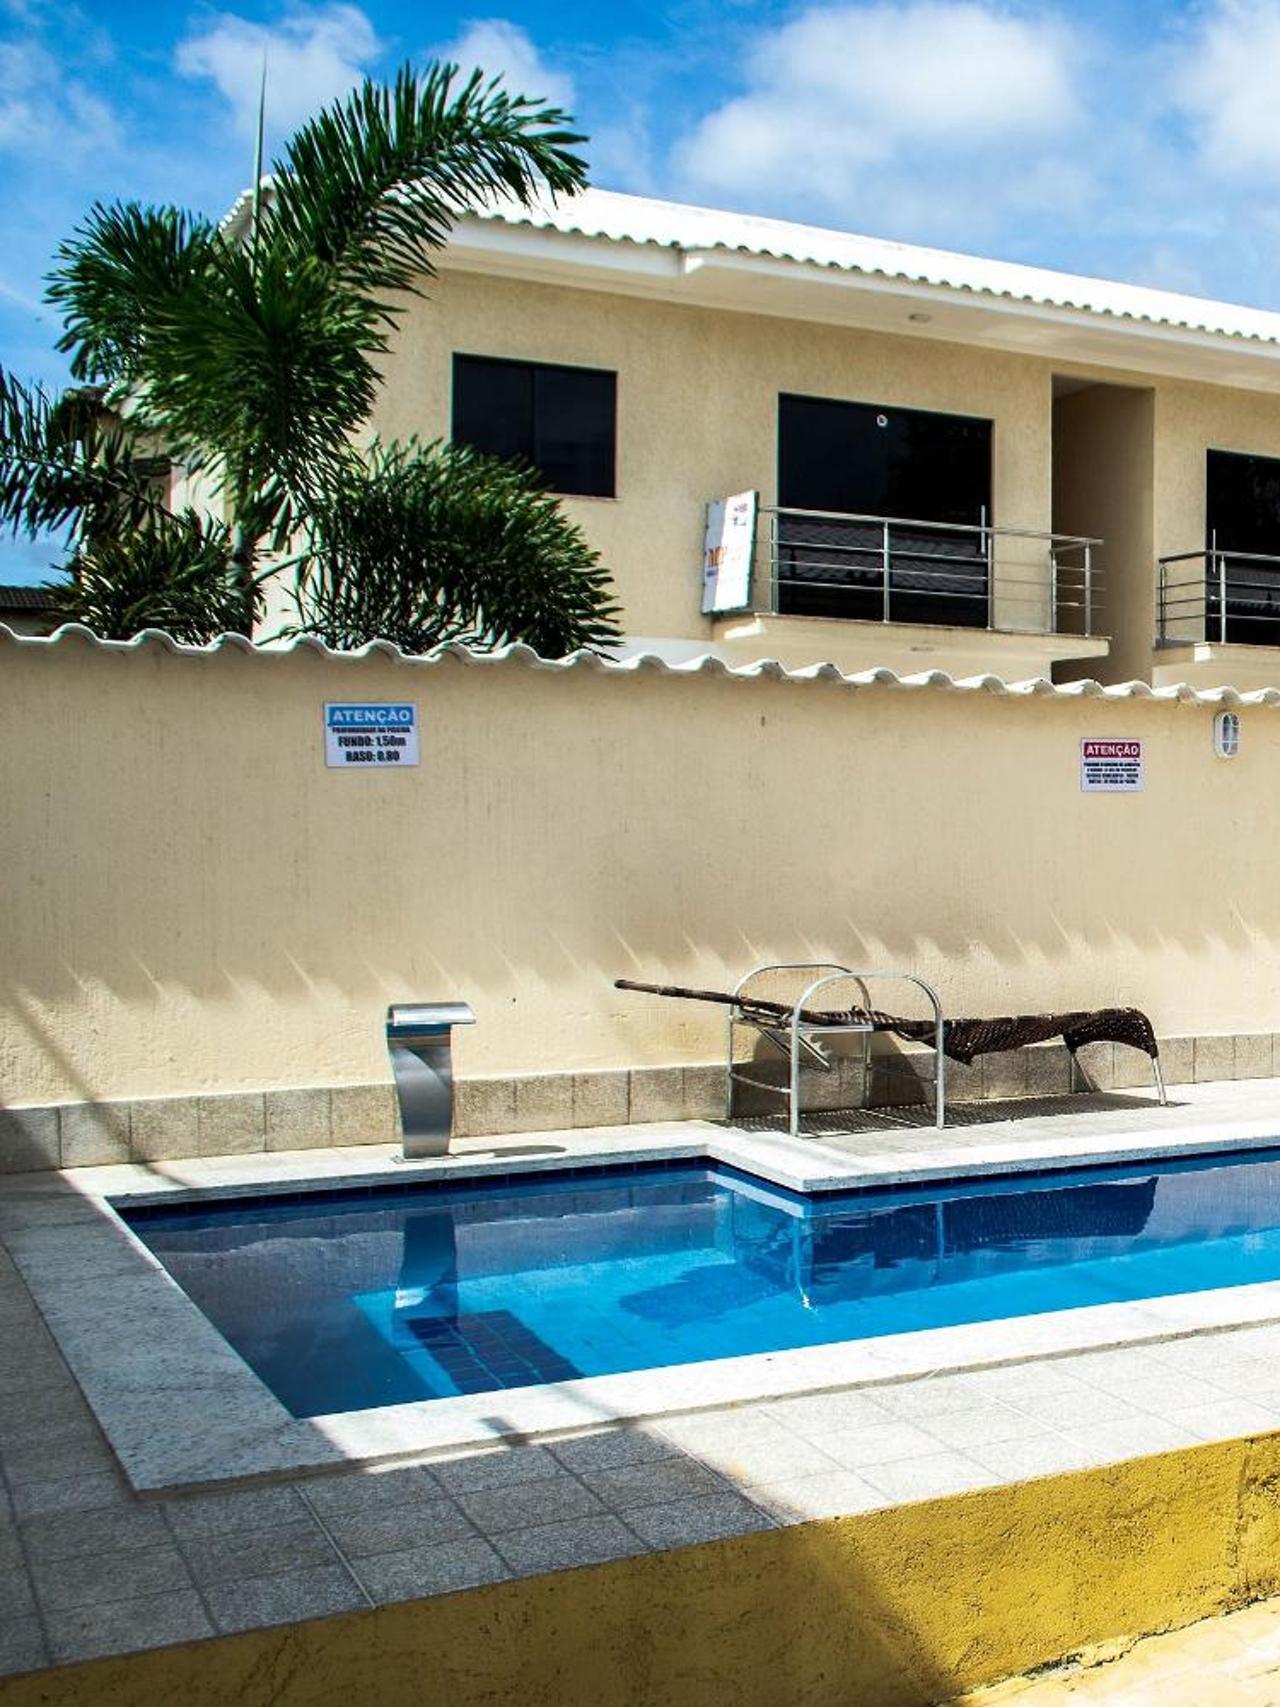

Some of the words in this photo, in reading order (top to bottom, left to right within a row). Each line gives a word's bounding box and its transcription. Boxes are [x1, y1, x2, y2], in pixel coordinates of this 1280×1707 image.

[333, 708, 410, 724] ATENÇÃO
[338, 736, 375, 747] FUNDO:
[1087, 744, 1138, 757] ATENÇÃO
